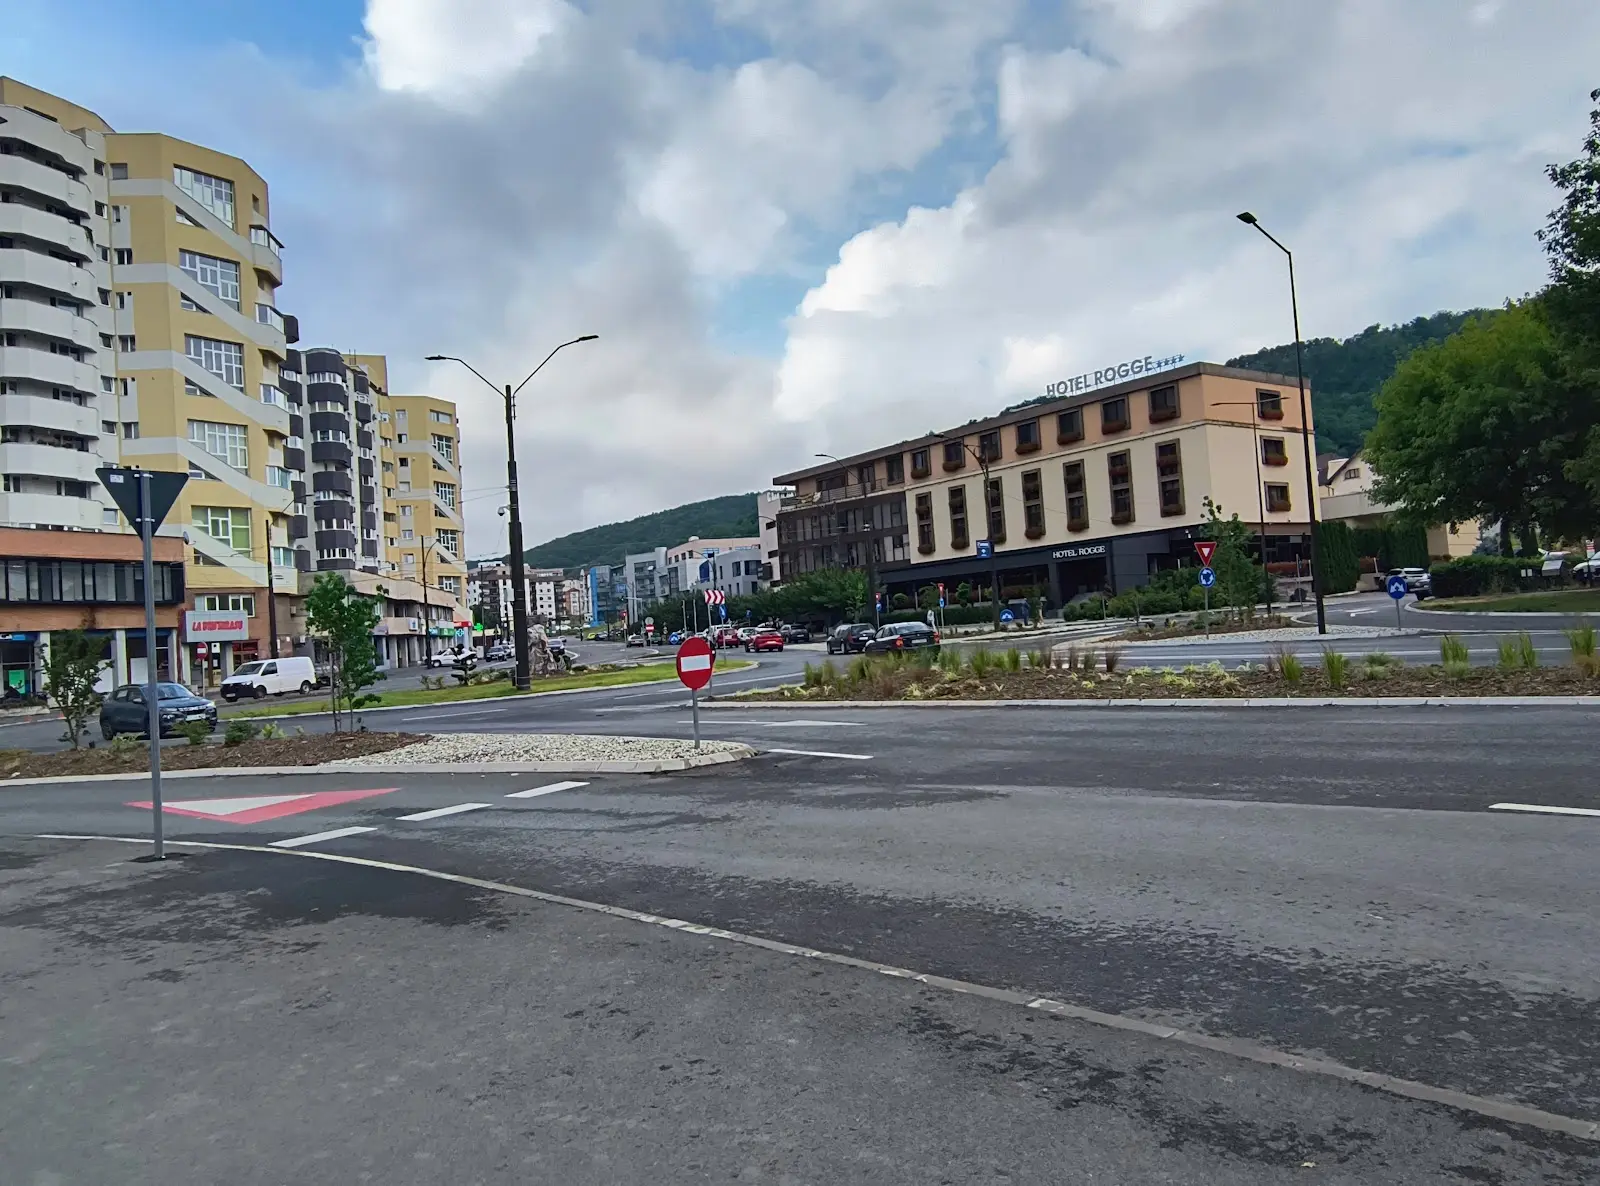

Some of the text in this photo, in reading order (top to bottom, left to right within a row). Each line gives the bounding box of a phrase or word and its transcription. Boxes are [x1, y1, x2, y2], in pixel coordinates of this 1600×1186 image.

[1046, 355, 1152, 396] HOTEL ROGGE
[1052, 545, 1106, 559] HOTEL ROGGE
